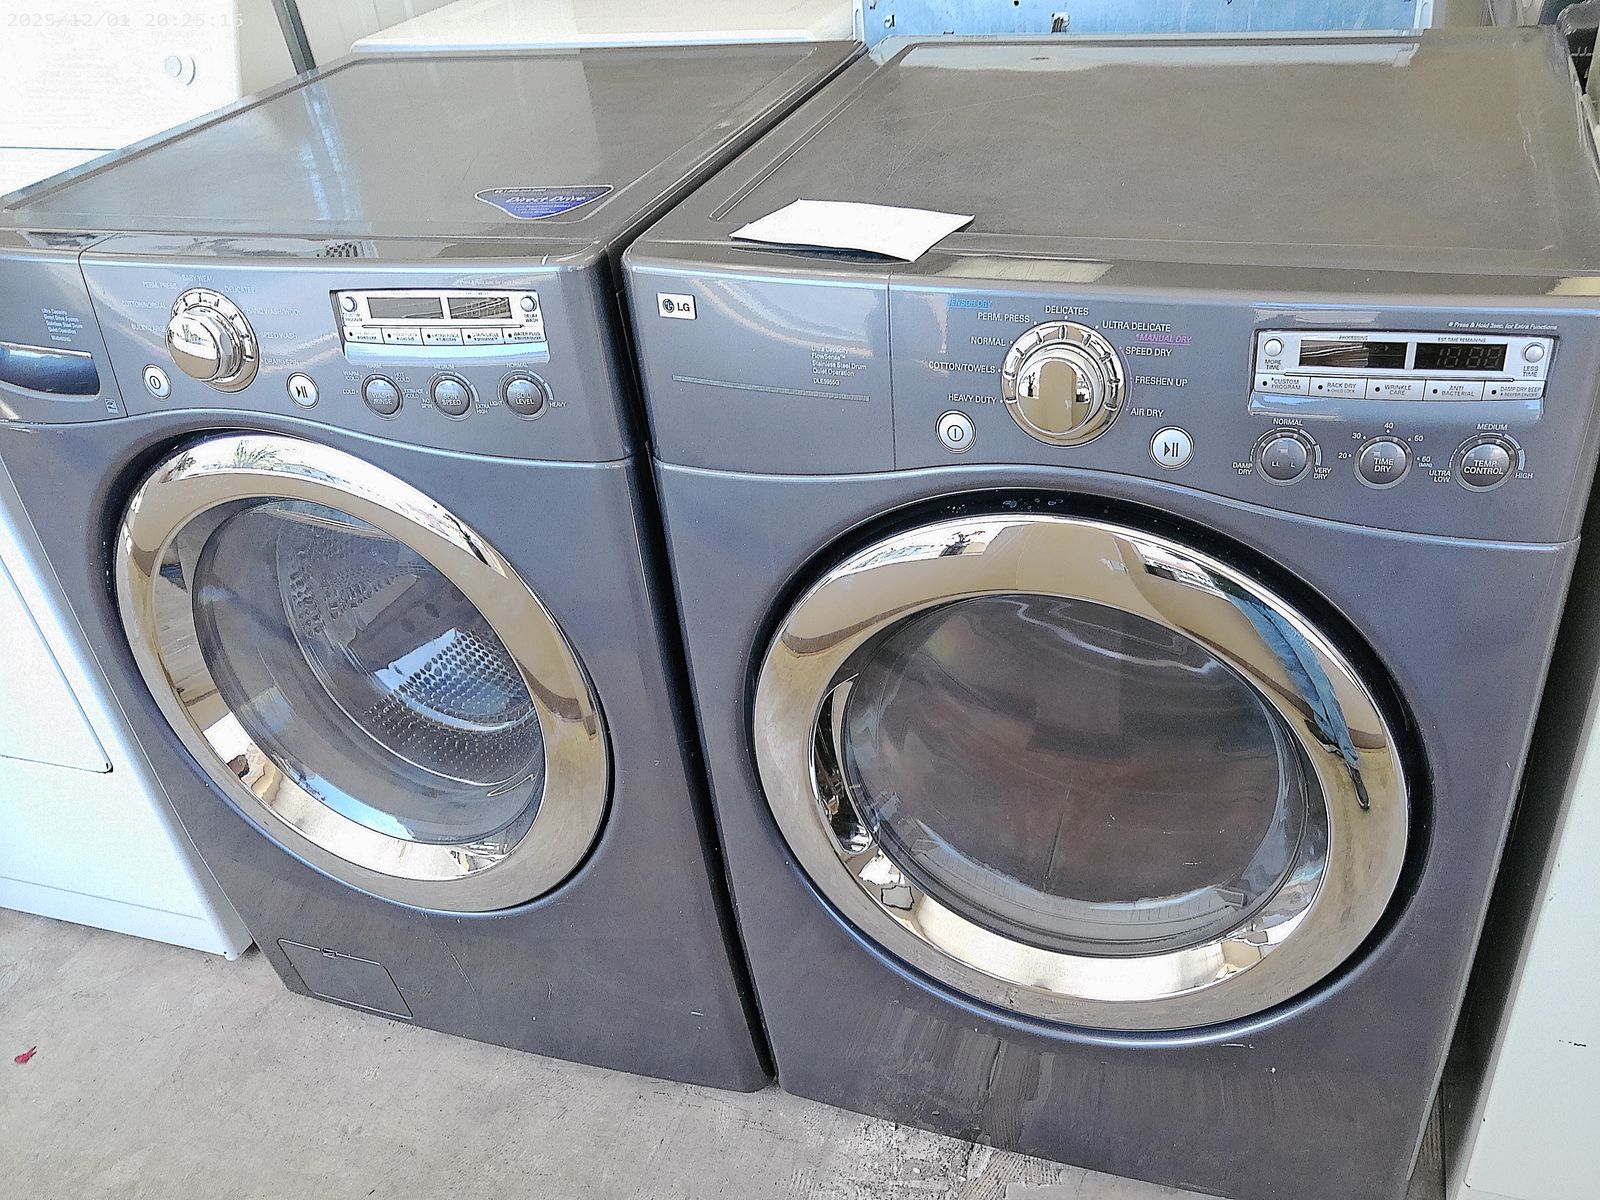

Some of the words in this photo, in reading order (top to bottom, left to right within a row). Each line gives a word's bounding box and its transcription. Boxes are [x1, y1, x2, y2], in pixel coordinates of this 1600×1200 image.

[677, 302, 691, 312] LG
[977, 299, 993, 308] DRY
[1045, 305, 1089, 316] DELICATES
[977, 312, 1003, 322] PERM.
[1004, 313, 1030, 323] PRESS
[1102, 320, 1130, 330] ULTRA
[1131, 321, 1171, 332] DELICATE
[970, 336, 1006, 347] NORMAL
[1175, 335, 1192, 344] DRY
[1125, 346, 1152, 356] SPEED
[1154, 347, 1172, 357] DRY
[851, 362, 867, 370] Drum
[928, 360, 996, 374] COTTON/TOWELS
[827, 368, 855, 377] Operation
[1135, 375, 1174, 387] FRESHEN
[1176, 377, 1188, 387] UP
[948, 393, 975, 403] HEAVY
[976, 395, 997, 405] DUTY
[1130, 408, 1145, 417] AIR
[1146, 408, 1164, 418] DRY
[1272, 418, 1303, 426] NORMAL
[1476, 423, 1508, 431] MEDIUM
[1373, 457, 1394, 466] TIME
[1374, 465, 1392, 473] DRY
[1463, 466, 1504, 475] CONTROL
